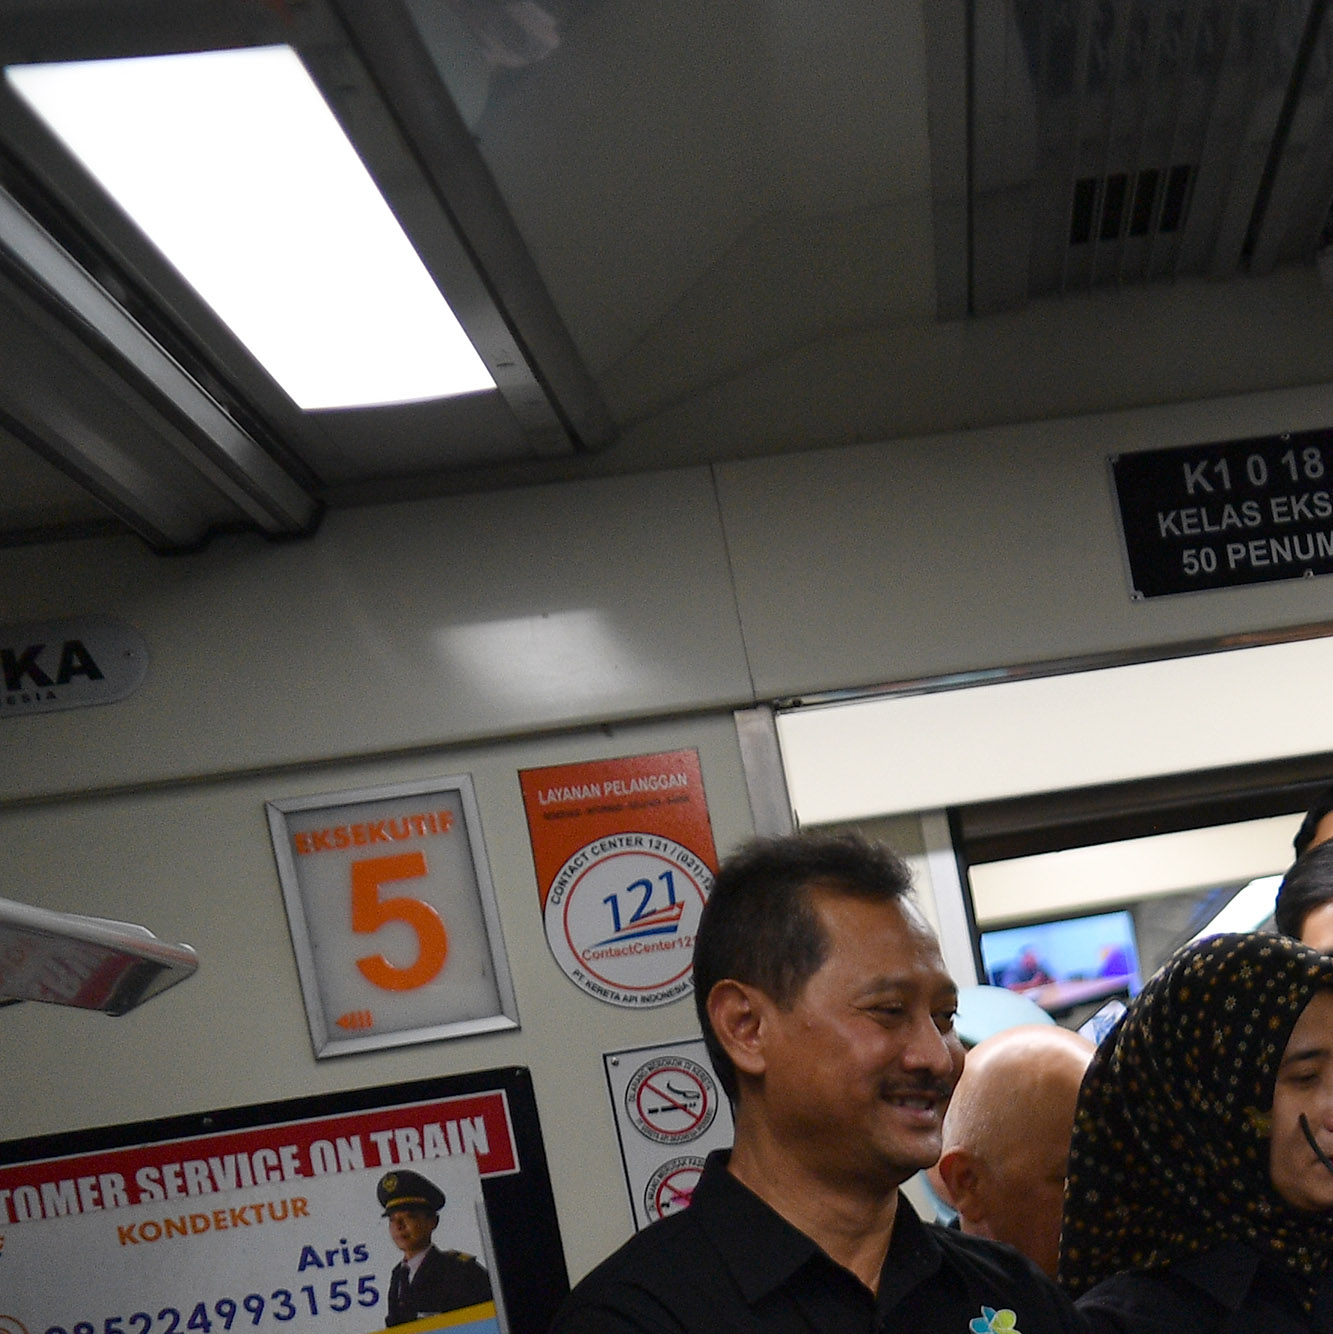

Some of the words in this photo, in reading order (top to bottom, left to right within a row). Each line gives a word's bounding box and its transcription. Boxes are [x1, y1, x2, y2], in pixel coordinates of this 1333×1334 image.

[1182, 457, 1231, 495] K1
[1281, 446, 1324, 481] 18
[1157, 501, 1262, 538] KELAS
[1181, 548, 1218, 576] 50
[538, 783, 600, 806] LAYANAN
[603, 773, 688, 797] PELANGGAN
[294, 810, 455, 856] EKSEKUTIF
[550, 852, 591, 906] CONTACT
[590, 836, 644, 856] CENTER
[649, 837, 669, 852] 121
[350, 852, 450, 992] 5
[602, 869, 678, 934] 121
[585, 980, 621, 1002] KERETA
[622, 994, 639, 1004] API
[640, 981, 690, 1004] INDONESIA
[135, 1144, 304, 1204] SERVICE
[309, 1135, 366, 1177] ON
[370, 1114, 491, 1166] TRAIN
[117, 1196, 311, 1246] KONDEKTUR
[297, 1238, 370, 1272] Aris
